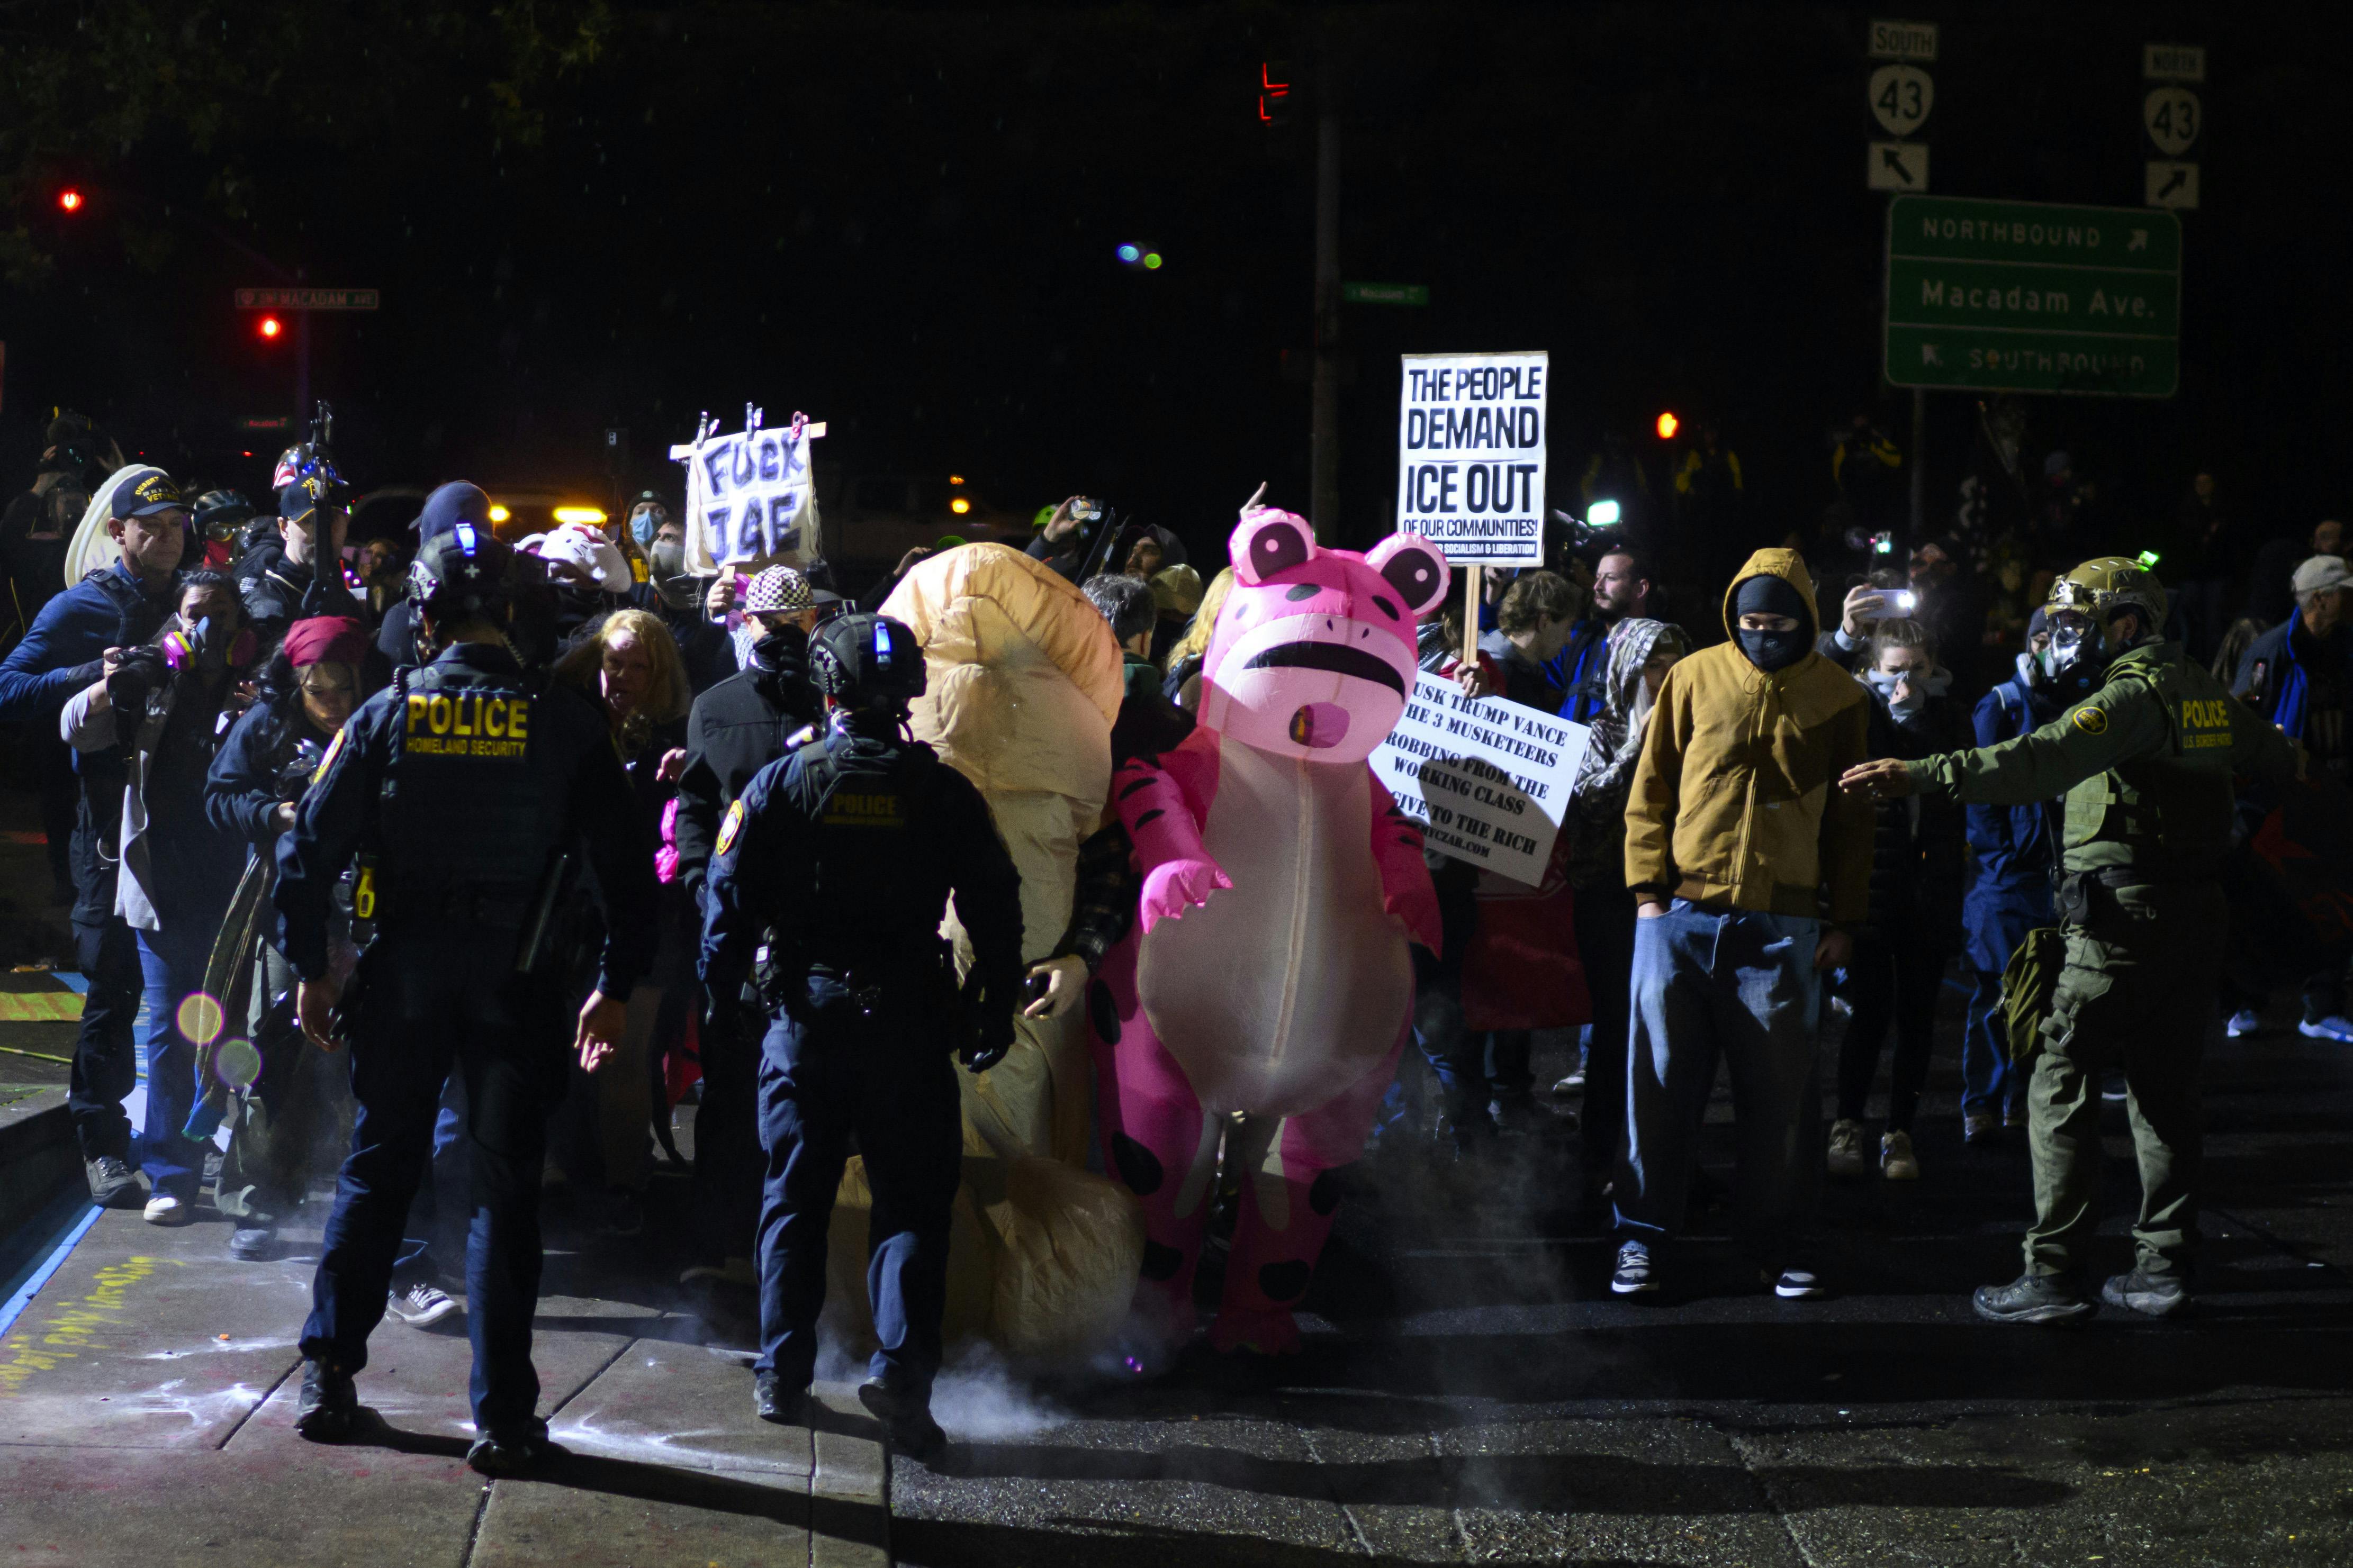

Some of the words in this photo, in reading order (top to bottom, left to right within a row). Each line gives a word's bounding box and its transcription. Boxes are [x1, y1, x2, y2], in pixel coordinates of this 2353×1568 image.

[1875, 26, 1932, 51] SOUTH
[2152, 53, 2197, 73] NORTH
[1878, 78, 1922, 120] 43
[2153, 100, 2195, 140] 43
[1923, 217, 2101, 248] NORTHBOUND
[279, 291, 347, 306] MACADAM
[1922, 279, 2069, 314] Macadam
[2088, 288, 2156, 319] Ave.
[1409, 368, 1452, 402] THE
[1455, 366, 1543, 401] PEOPLE
[1407, 406, 1539, 450] DEMAND
[703, 430, 806, 496] FUCK
[1406, 465, 1458, 513] ICE
[1466, 464, 1538, 513] OUT
[1403, 519, 1418, 534] OF
[1420, 519, 1445, 537] OUR
[1447, 519, 1538, 537] COMMUNITIES!
[1444, 543, 1484, 554] SOCIALISM
[1492, 543, 1535, 554] LIBERATION
[406, 694, 529, 739] POLICE
[1412, 681, 1448, 705] USK
[1450, 694, 1510, 726] TRUMP
[1513, 715, 1568, 747] VANCE
[2182, 699, 2230, 729] POLICE
[406, 737, 468, 755] HOMELAND
[470, 739, 527, 757] SECURITY
[1405, 703, 1431, 724] HE
[1432, 713, 1444, 728] 3
[1446, 717, 1559, 768] MUSKETEERS
[1385, 731, 1461, 768] ROBBING
[1463, 757, 1511, 786] FROM
[1515, 773, 1549, 800] THE
[1394, 756, 1473, 798] WORKING
[1474, 785, 1526, 815] CLASS
[832, 793, 898, 817] POLICE
[1431, 804, 1454, 826] TO
[1457, 813, 1489, 838] THE
[1492, 825, 1538, 856] RICH
